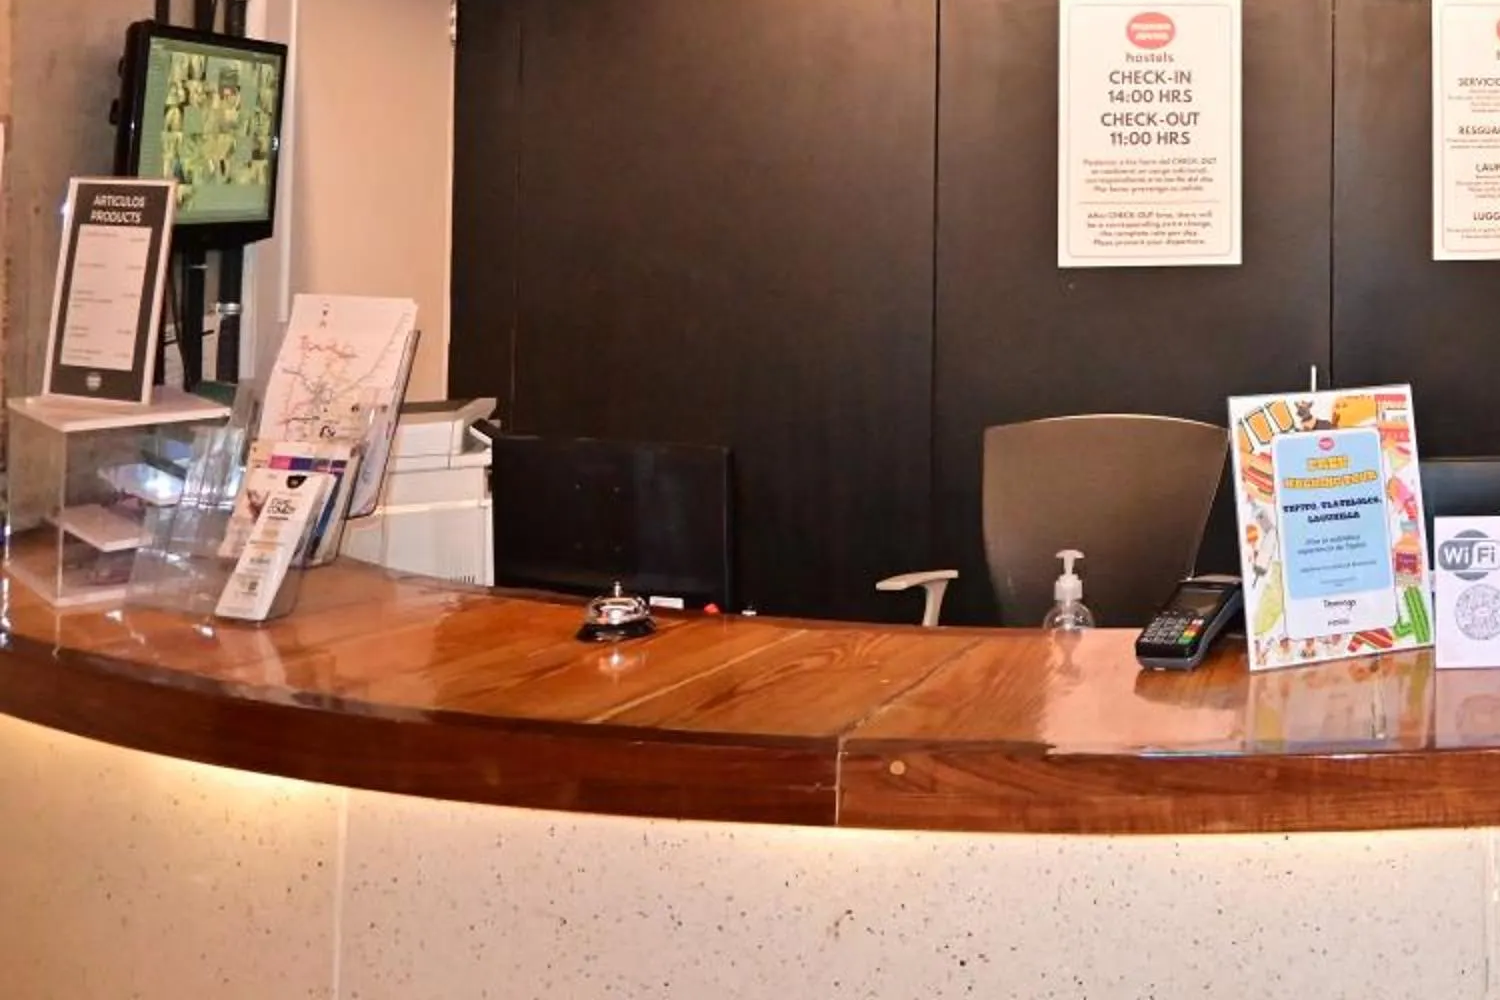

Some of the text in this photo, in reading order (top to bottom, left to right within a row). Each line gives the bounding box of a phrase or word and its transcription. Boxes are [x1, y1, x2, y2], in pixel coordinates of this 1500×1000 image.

[1109, 70, 1192, 85] CHECK-IN
[1108, 89, 1193, 104] 14:00 HRS
[1100, 111, 1200, 127] CHECK-OUT
[1109, 131, 1191, 146] 11:00 HRS
[90, 209, 142, 224] PRODUCTS
[1443, 546, 1496, 565] WiFi
